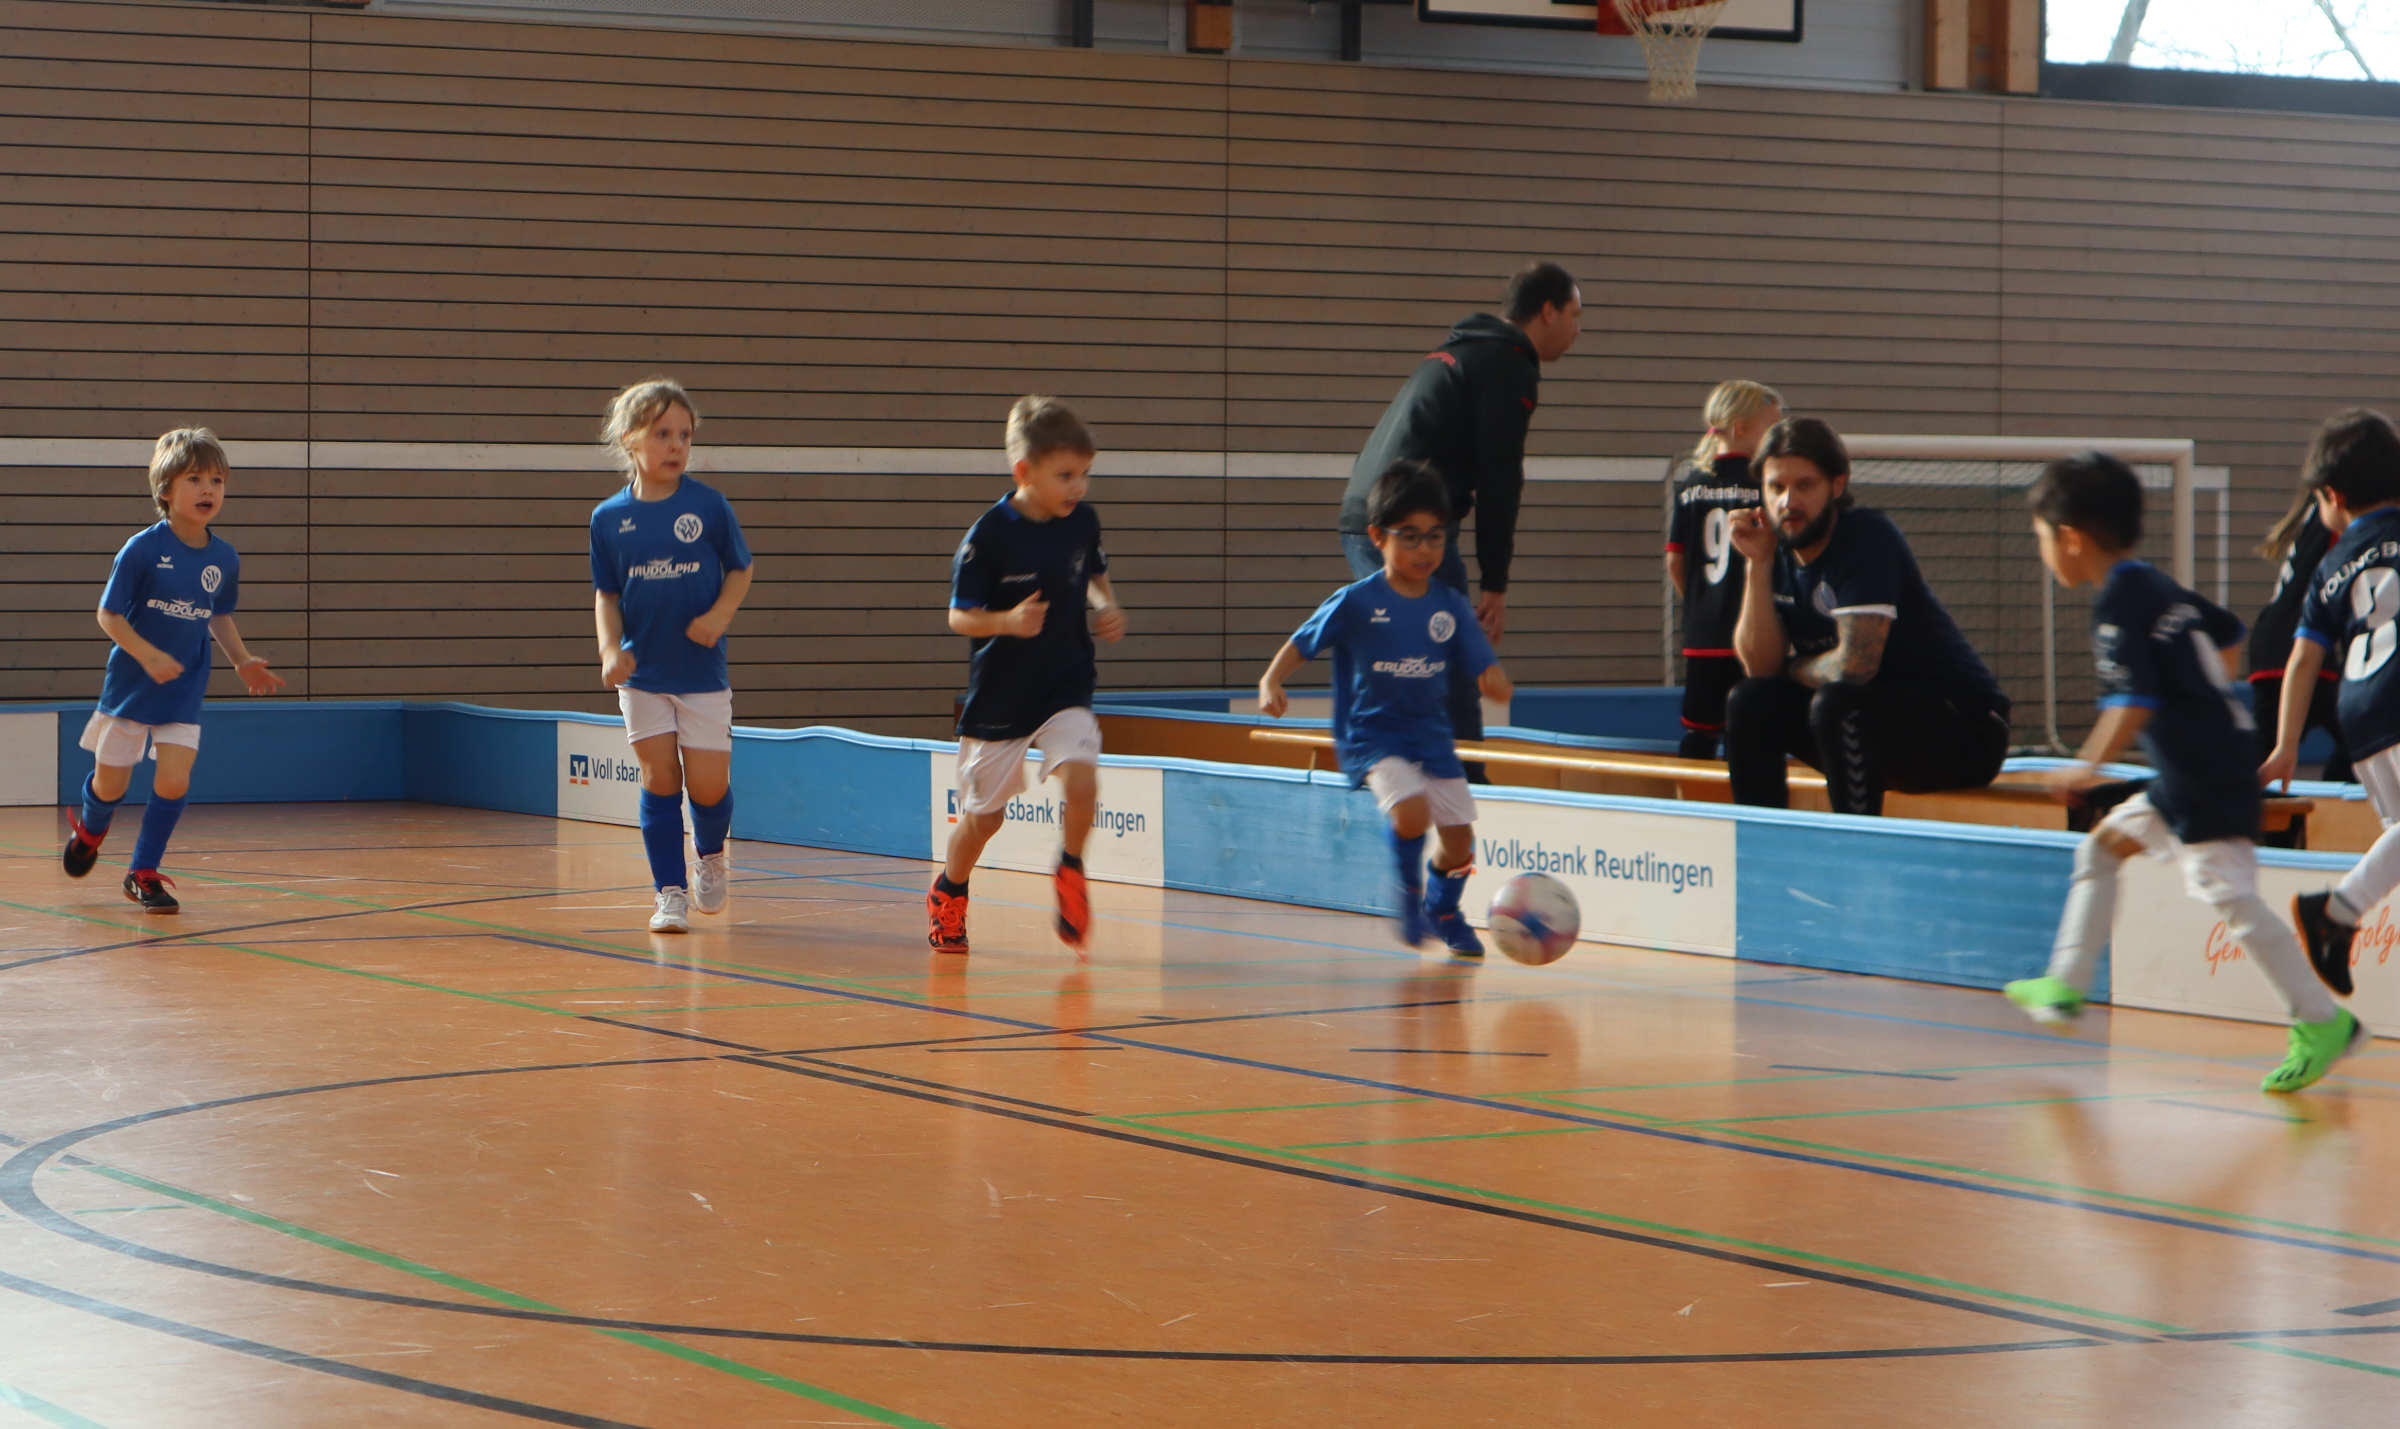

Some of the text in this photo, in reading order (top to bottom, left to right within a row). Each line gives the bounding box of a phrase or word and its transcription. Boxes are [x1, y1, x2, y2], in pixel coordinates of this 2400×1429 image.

[1705, 507, 1731, 584] 9
[1483, 838, 1713, 893] Volksbank Reutlingen
